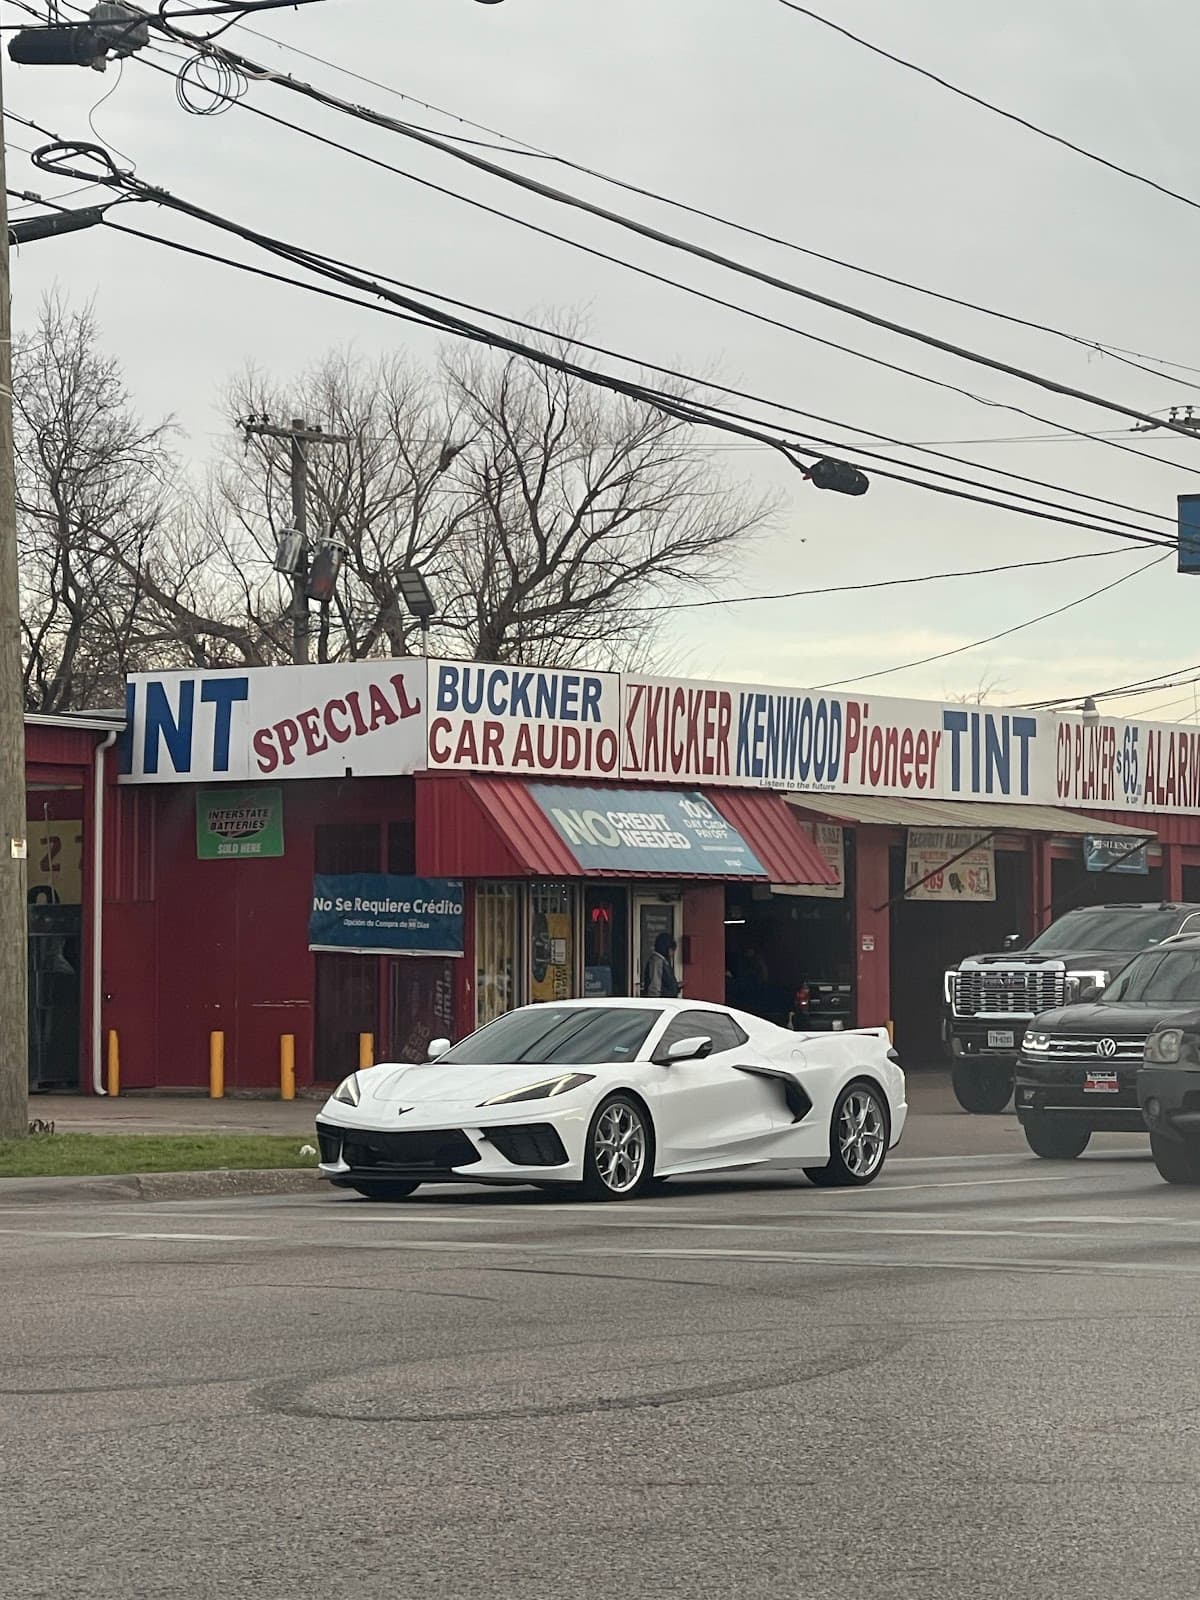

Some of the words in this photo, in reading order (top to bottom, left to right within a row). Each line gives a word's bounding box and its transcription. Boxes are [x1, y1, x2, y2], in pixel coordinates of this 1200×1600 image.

[437, 666, 602, 722] BUCKNER
[253, 674, 421, 774] SPECIAL
[429, 717, 504, 766] CAR
[511, 723, 618, 773] AUDIO
[645, 685, 731, 776] KICKER
[736, 692, 842, 782] KENWOOD
[843, 701, 941, 790] Pioneer
[944, 710, 1036, 796] TINT
[1057, 721, 1071, 798] CD
[1075, 724, 1115, 801] PLAYER
[760, 780, 784, 788] Listen
[209, 808, 268, 820] INTERSTATE
[210, 820, 265, 831] BATTERIES
[552, 808, 621, 847] NO
[606, 812, 672, 831] CREDIT
[217, 843, 238, 854] SOLD
[241, 843, 261, 853] HERE
[617, 830, 691, 849] NEEDED
[313, 897, 332, 912] No
[335, 898, 352, 911] Se
[354, 898, 410, 915] Requiere
[413, 899, 463, 914] Crédito
